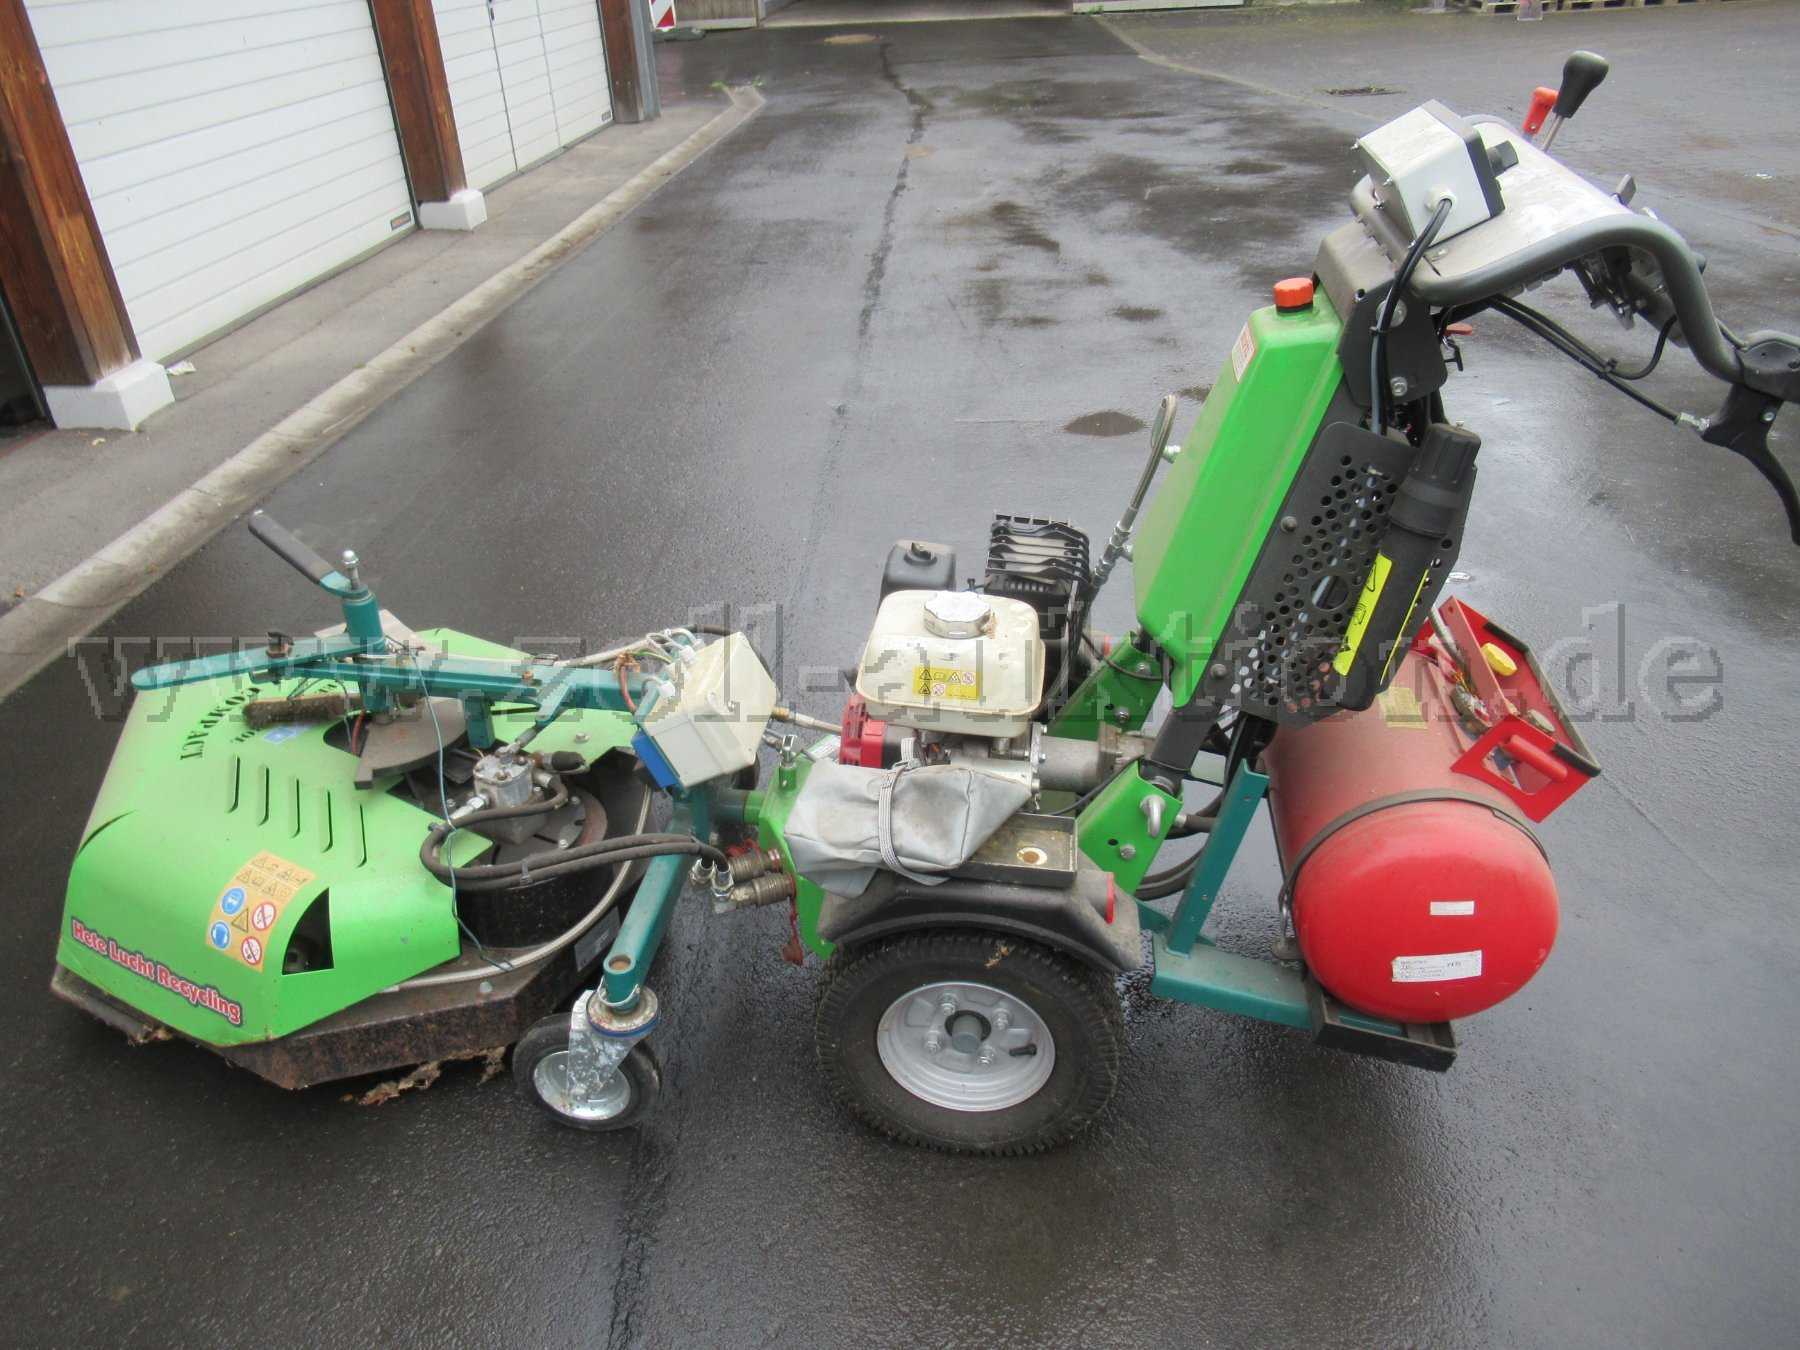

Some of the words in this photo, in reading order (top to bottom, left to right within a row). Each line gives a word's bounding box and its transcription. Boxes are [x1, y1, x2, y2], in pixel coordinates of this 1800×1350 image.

[180, 687, 261, 760] COMPACT
[72, 917, 108, 956] Hete
[108, 938, 156, 980] Lucht
[156, 961, 242, 1026] Recycling
